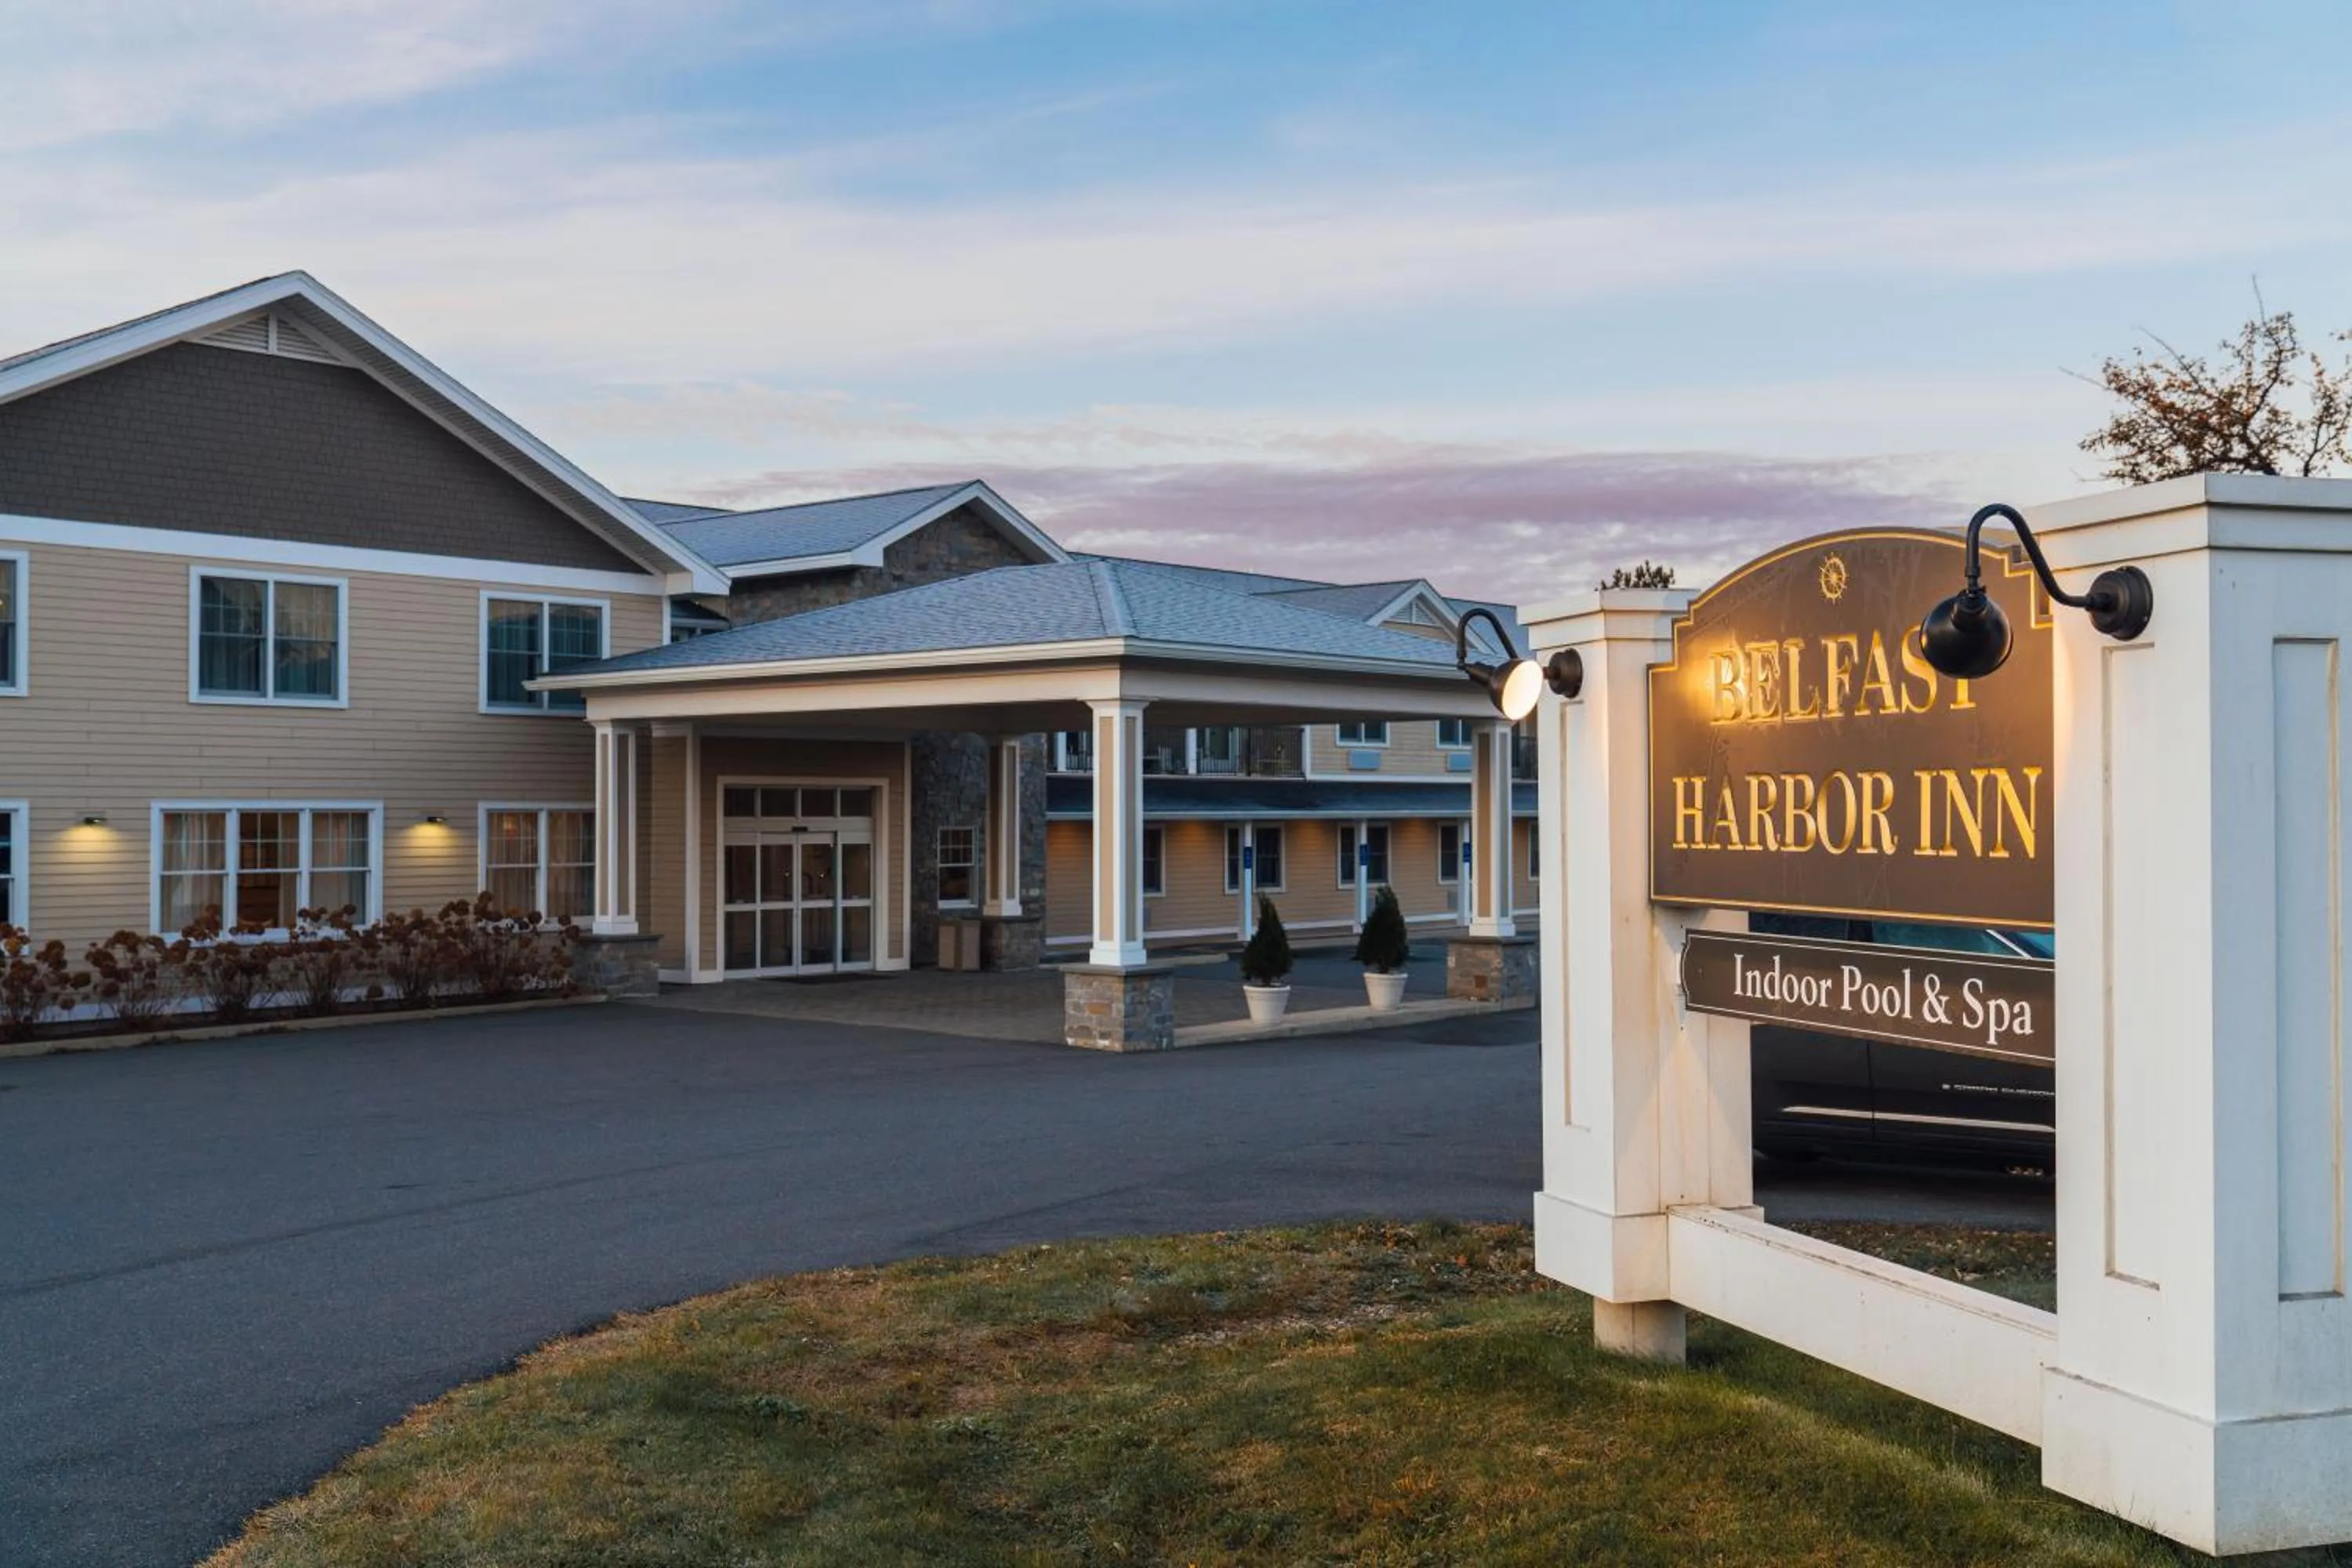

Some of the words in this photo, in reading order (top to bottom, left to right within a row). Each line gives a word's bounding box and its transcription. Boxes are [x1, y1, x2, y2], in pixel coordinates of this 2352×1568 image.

[1672, 770, 1897, 856] HARBOR
[1914, 767, 2042, 858] INN
[1733, 953, 1831, 1008] Indoor
[1840, 965, 1911, 1018] Pool
[1922, 973, 1952, 1025] &
[1962, 978, 2034, 1045] Spa
